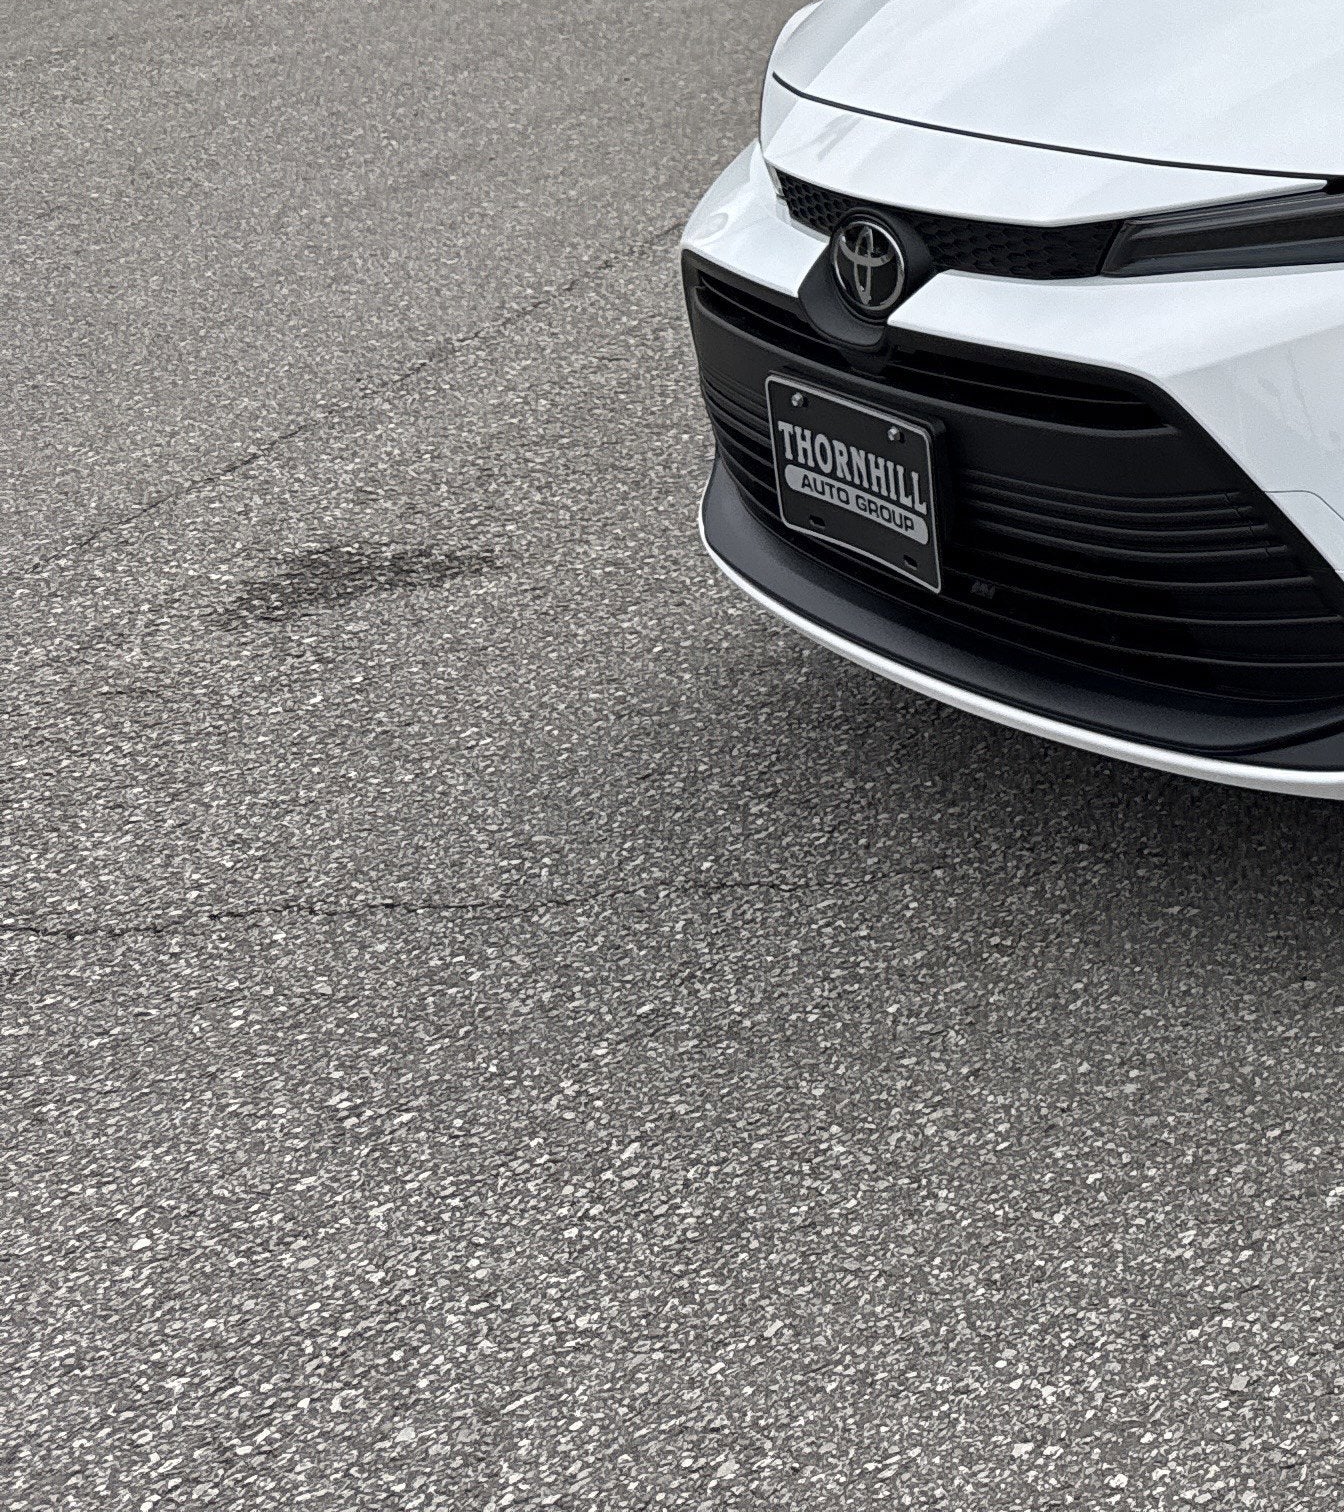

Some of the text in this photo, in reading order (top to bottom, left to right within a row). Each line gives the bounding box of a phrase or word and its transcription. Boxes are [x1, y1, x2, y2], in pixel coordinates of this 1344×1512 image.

[777, 421, 928, 515] THORNHILL
[801, 474, 915, 532] AUTO GROUP
